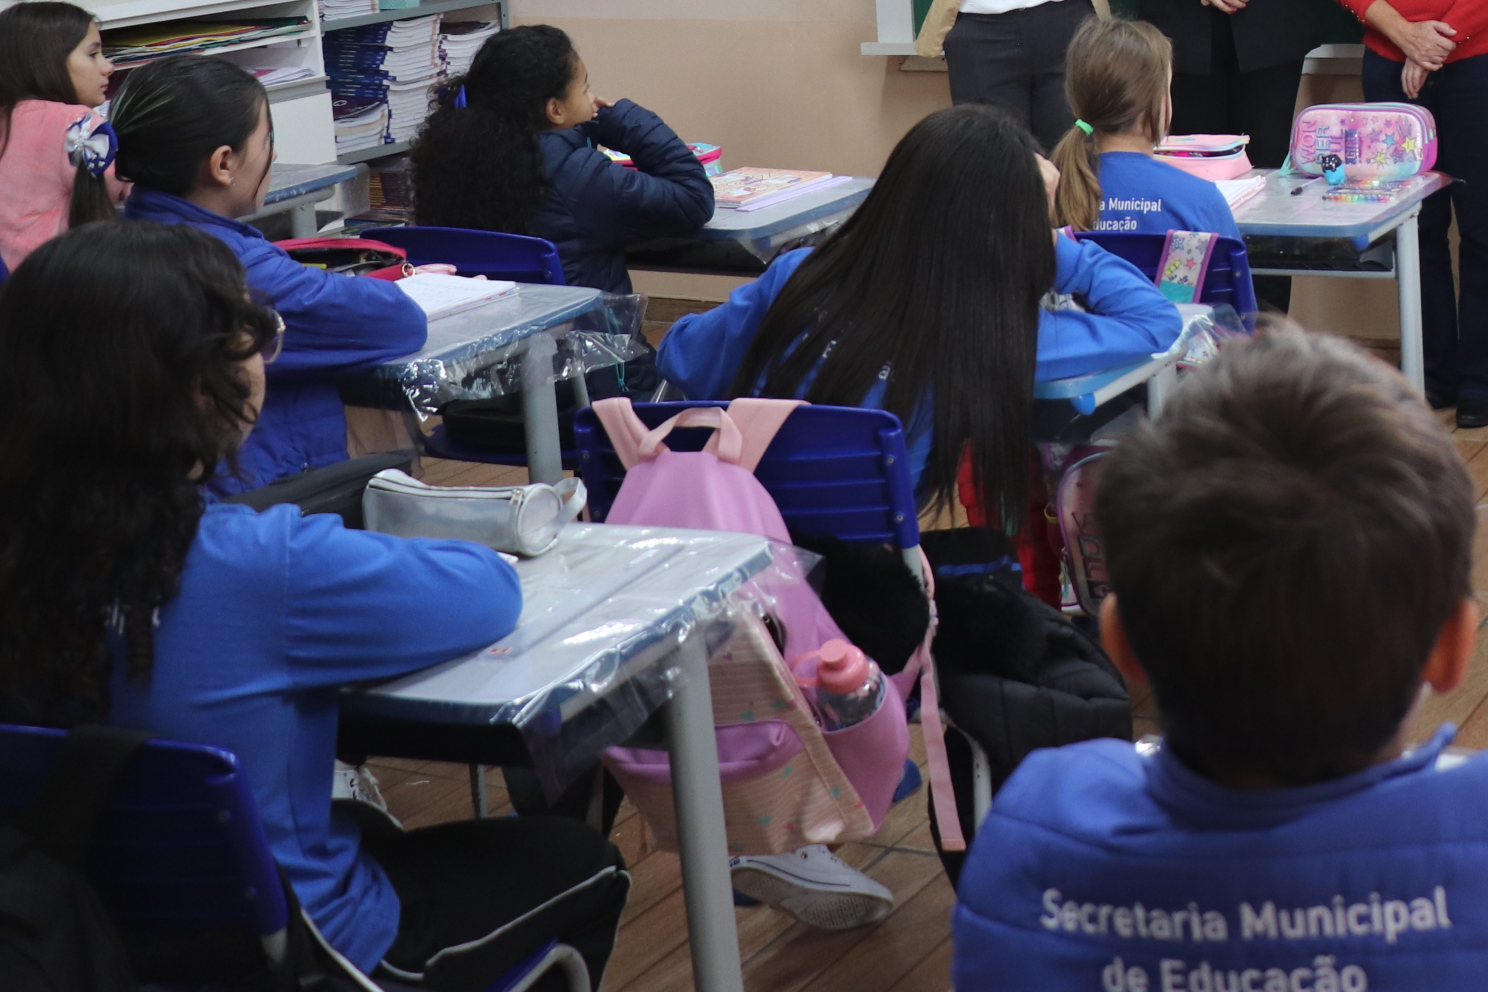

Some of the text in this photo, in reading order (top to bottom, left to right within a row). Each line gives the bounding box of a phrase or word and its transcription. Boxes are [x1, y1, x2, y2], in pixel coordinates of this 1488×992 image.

[1301, 121, 1316, 164] WON
[1330, 129, 1345, 153] UL
[1108, 198, 1162, 214] Municipal
[1093, 216, 1137, 232] ducação
[1040, 885, 1452, 945] Secretaria Municipal
[1102, 953, 1369, 992] de Educação
